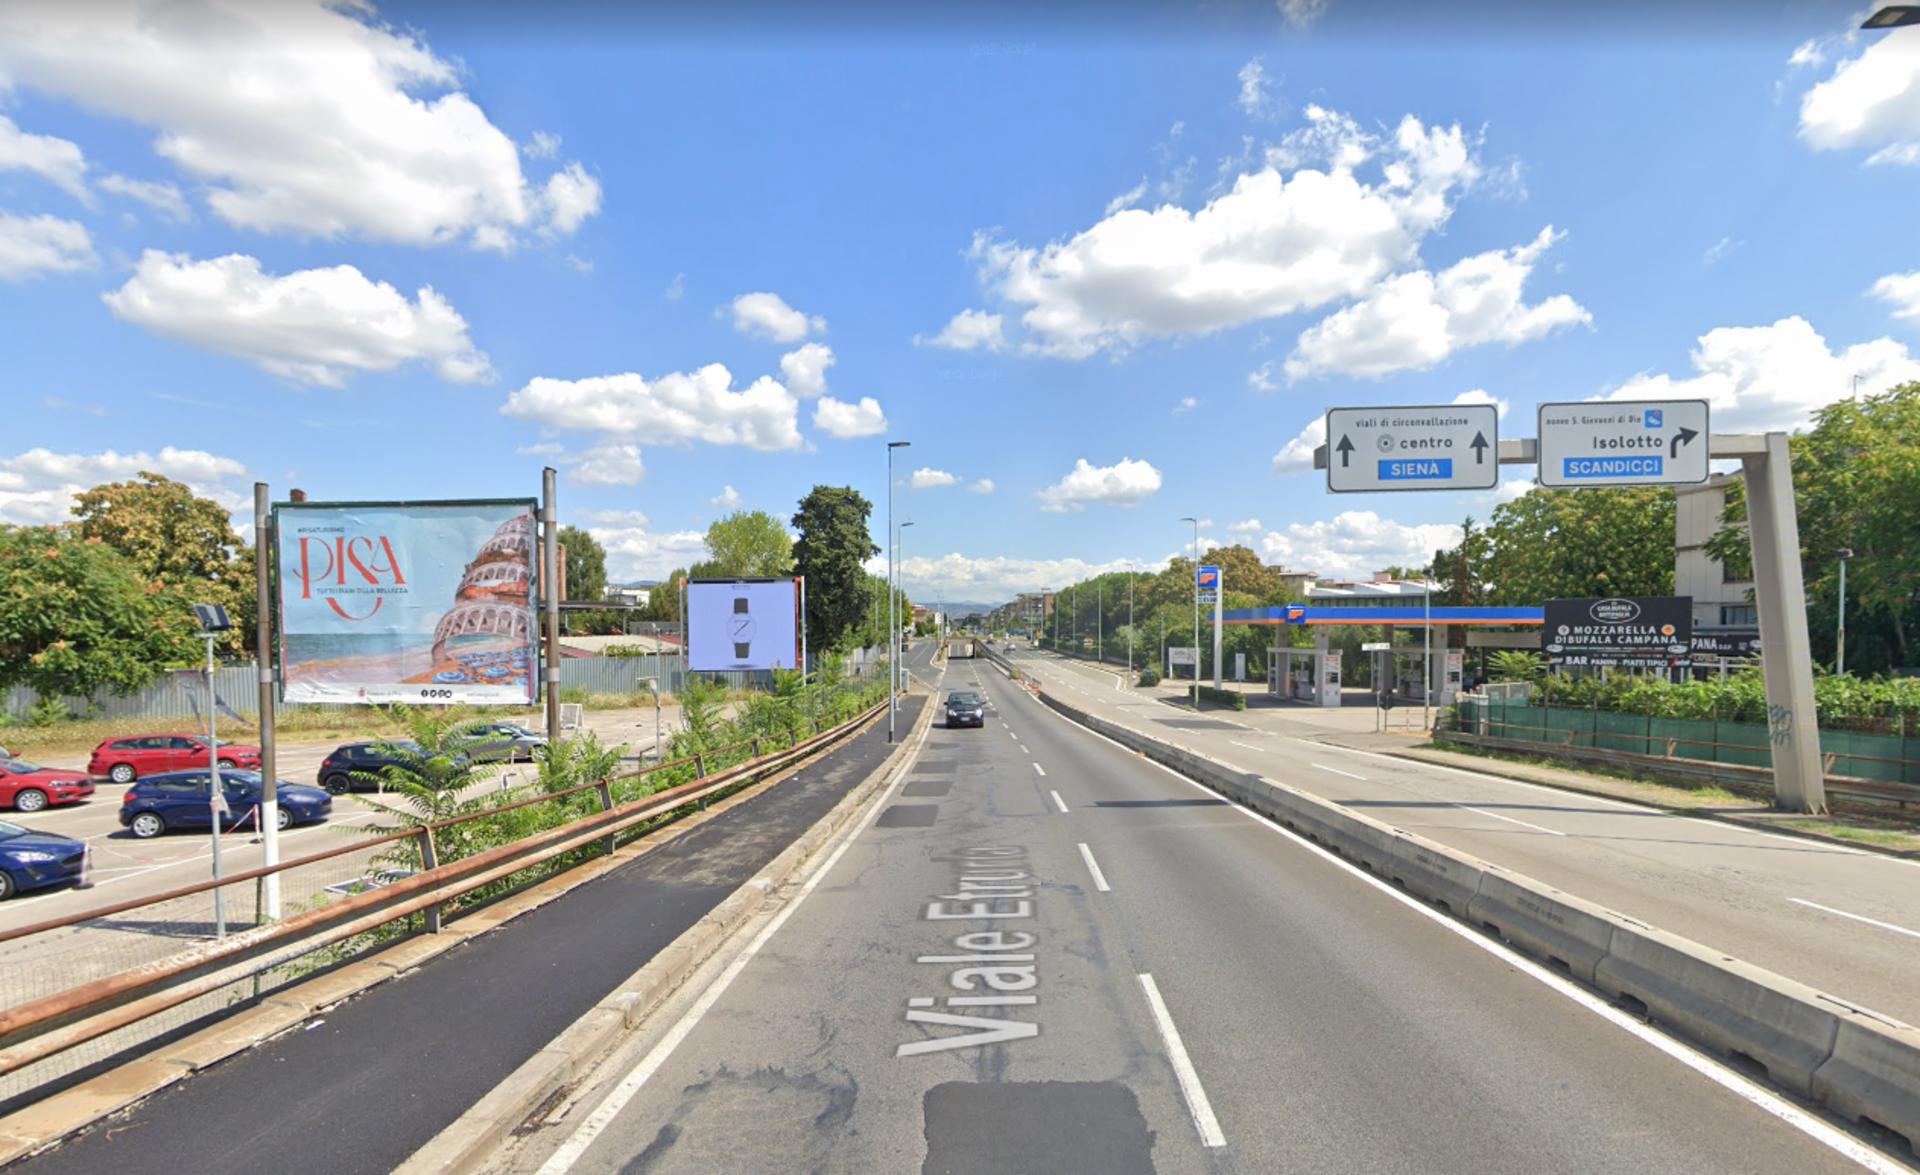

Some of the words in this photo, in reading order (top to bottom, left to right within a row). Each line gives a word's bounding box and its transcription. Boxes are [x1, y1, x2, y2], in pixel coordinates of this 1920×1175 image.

[1355, 418, 1377, 429] viali
[1380, 417, 1389, 428] di
[1392, 416, 1469, 428] circonvallazione
[1581, 415, 1616, 425] Giovanni
[1617, 415, 1626, 424] di
[1628, 415, 1642, 424] Dio
[1399, 436, 1453, 449] centro
[1592, 435, 1664, 449] Isolotto
[1391, 462, 1440, 476] SIENA
[1568, 459, 1660, 475] SCANDICCI
[292, 535, 407, 599] PISA
[1573, 625, 1657, 635] MOZZARELLA
[1617, 635, 1678, 644] CAMPANA
[1565, 656, 1588, 665] BAR
[1590, 658, 1617, 666] PANINI
